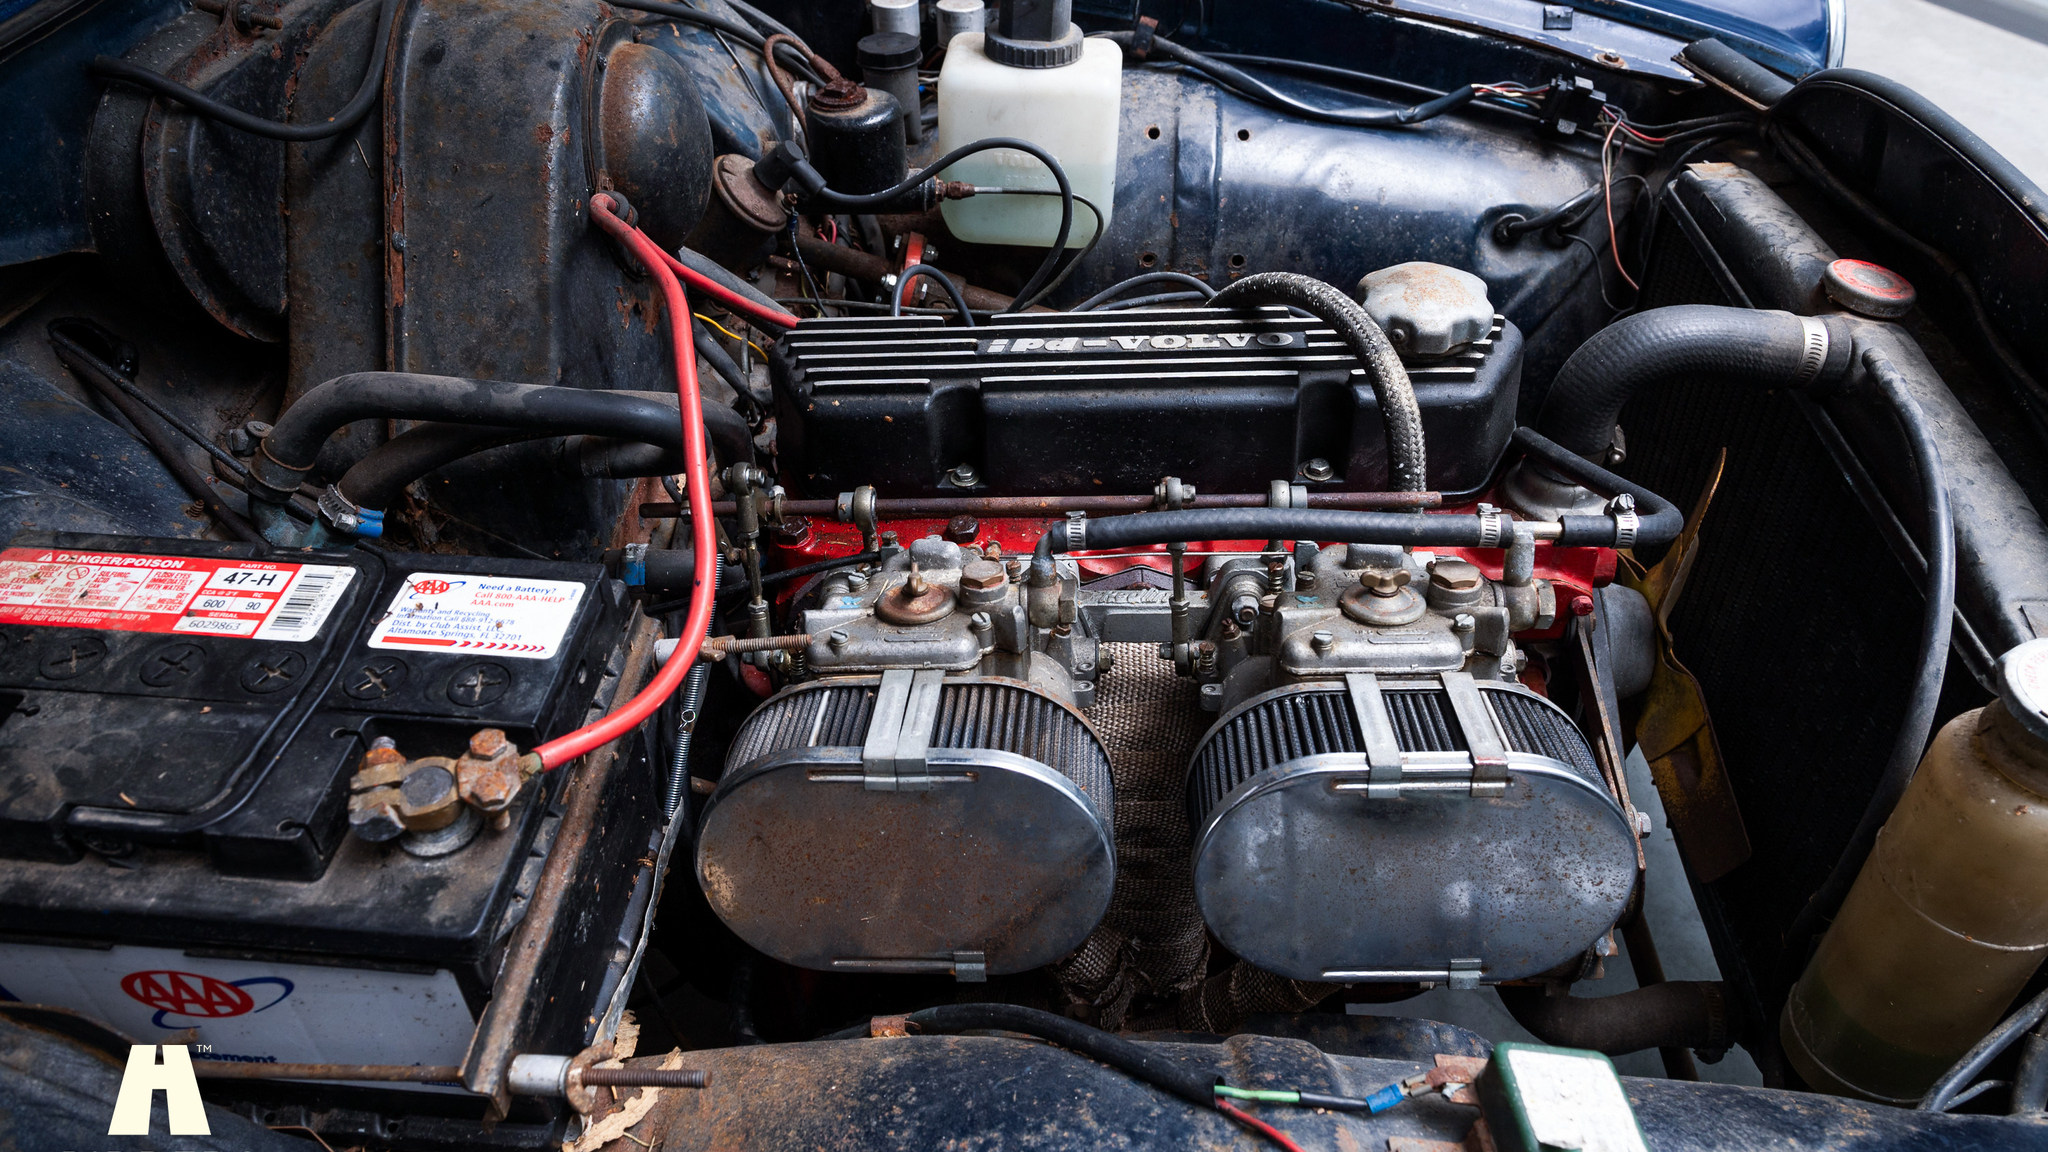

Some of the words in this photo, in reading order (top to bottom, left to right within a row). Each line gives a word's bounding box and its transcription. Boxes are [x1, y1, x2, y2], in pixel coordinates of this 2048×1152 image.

[56, 554, 185, 569] DANGER/POISON
[149, 577, 195, 585] IMMEDIATELY
[223, 571, 278, 586] 47-H
[414, 579, 450, 595] AAA
[478, 583, 505, 591] Need
[514, 585, 557, 595] Battery?
[474, 591, 494, 599] Call
[495, 592, 565, 603] 800-AAA-HELP
[203, 599, 226, 608] 600
[245, 601, 261, 610] 90
[470, 599, 515, 608] AAA.com
[454, 609, 491, 618] Recycling
[188, 620, 242, 631] 6029863
[415, 621, 428, 629] by
[430, 621, 451, 629] Club
[386, 626, 437, 636] Altamonte
[480, 631, 489, 639] FL
[492, 632, 522, 641] 32701
[121, 970, 255, 1018] AAA
[190, 1051, 277, 1063] acement
